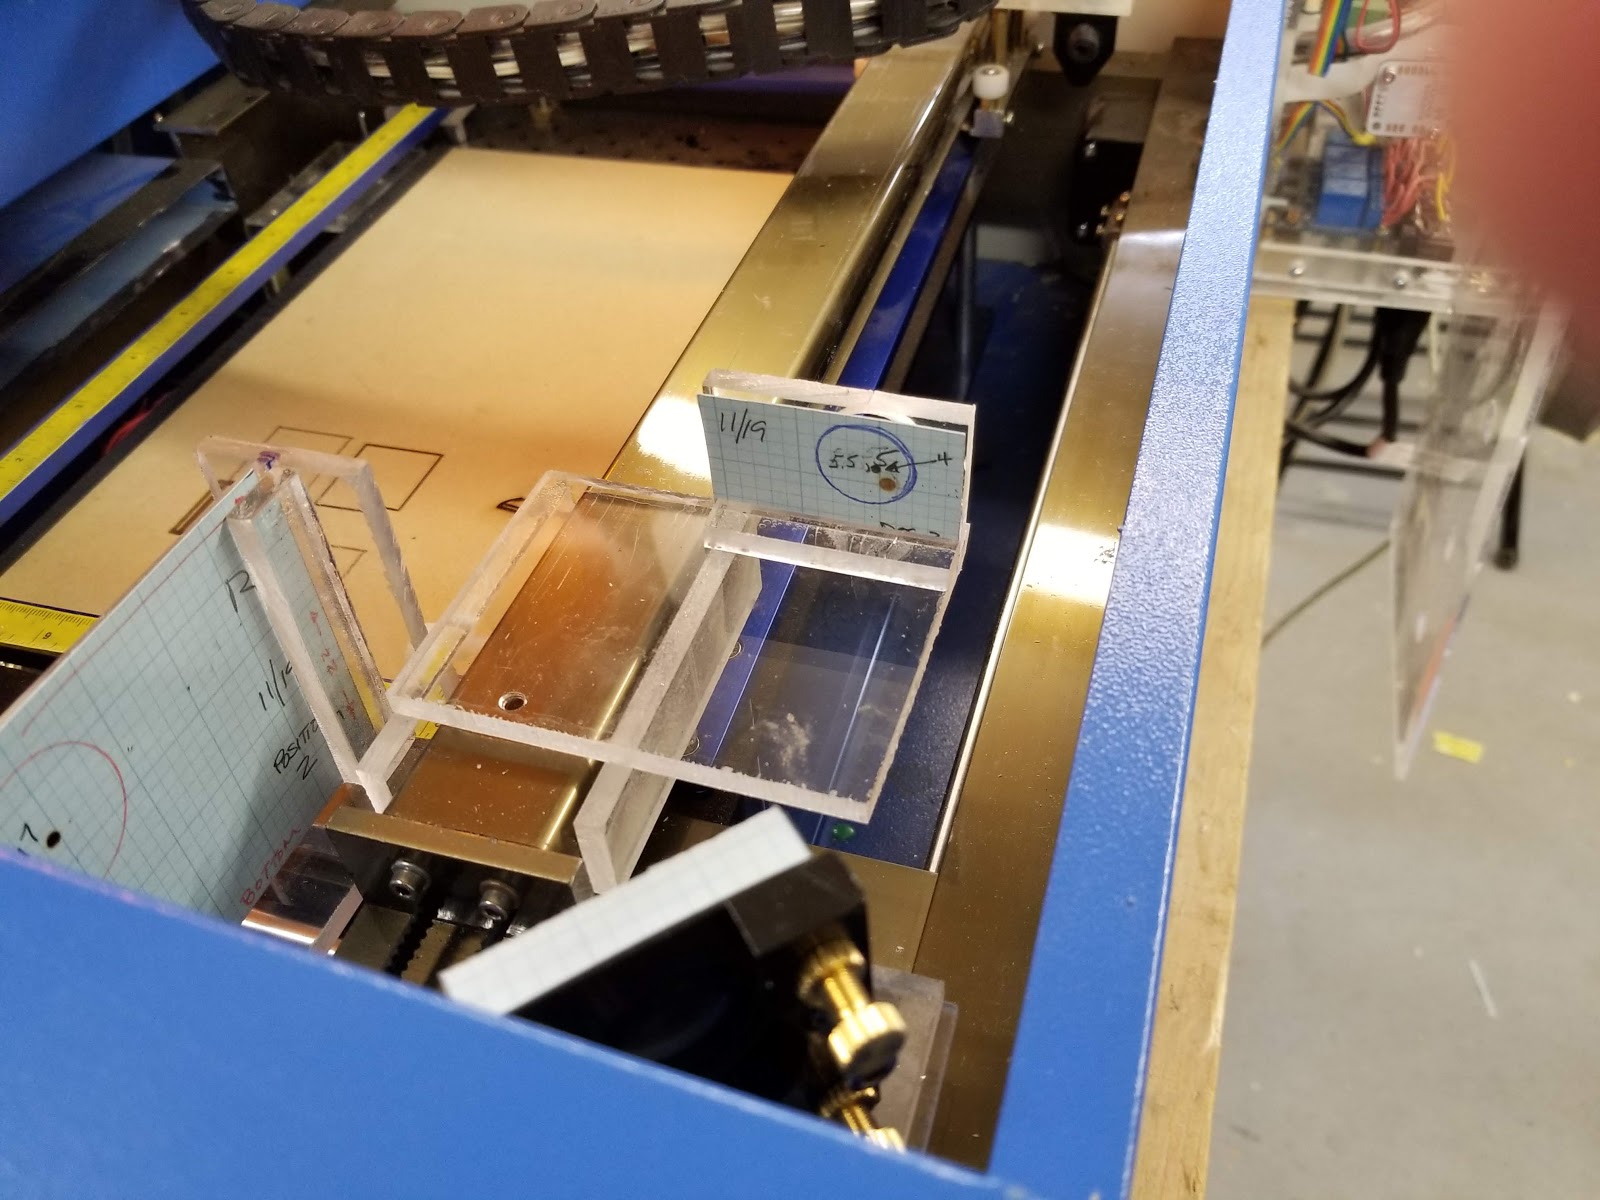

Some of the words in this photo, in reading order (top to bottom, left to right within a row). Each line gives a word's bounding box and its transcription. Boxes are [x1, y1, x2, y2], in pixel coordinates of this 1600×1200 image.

[720, 408, 767, 444] 11/19
[273, 715, 328, 774] POSITIO
[297, 754, 318, 781] 2
